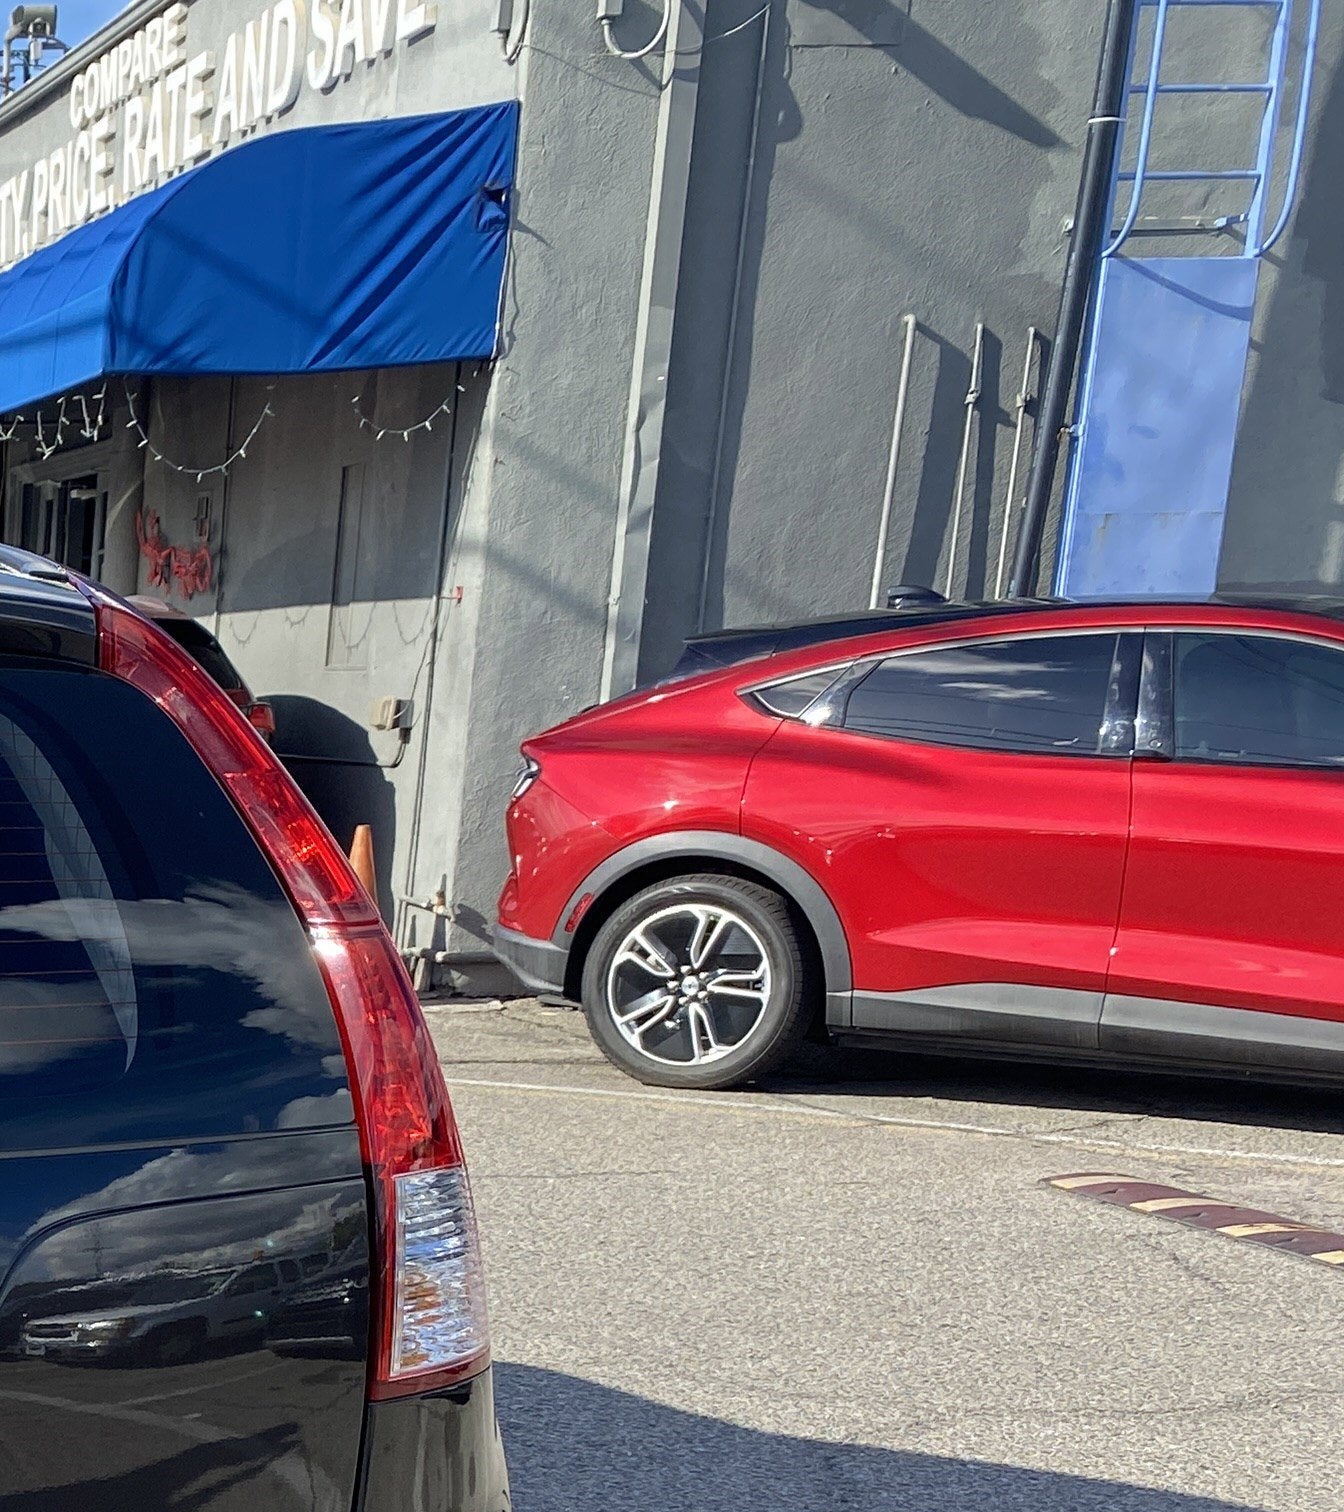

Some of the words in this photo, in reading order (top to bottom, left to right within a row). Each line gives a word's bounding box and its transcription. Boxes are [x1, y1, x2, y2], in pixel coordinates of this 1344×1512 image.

[70, 3, 188, 129] COMPARE
[123, 52, 215, 194] RATE
[213, 0, 304, 144] AND
